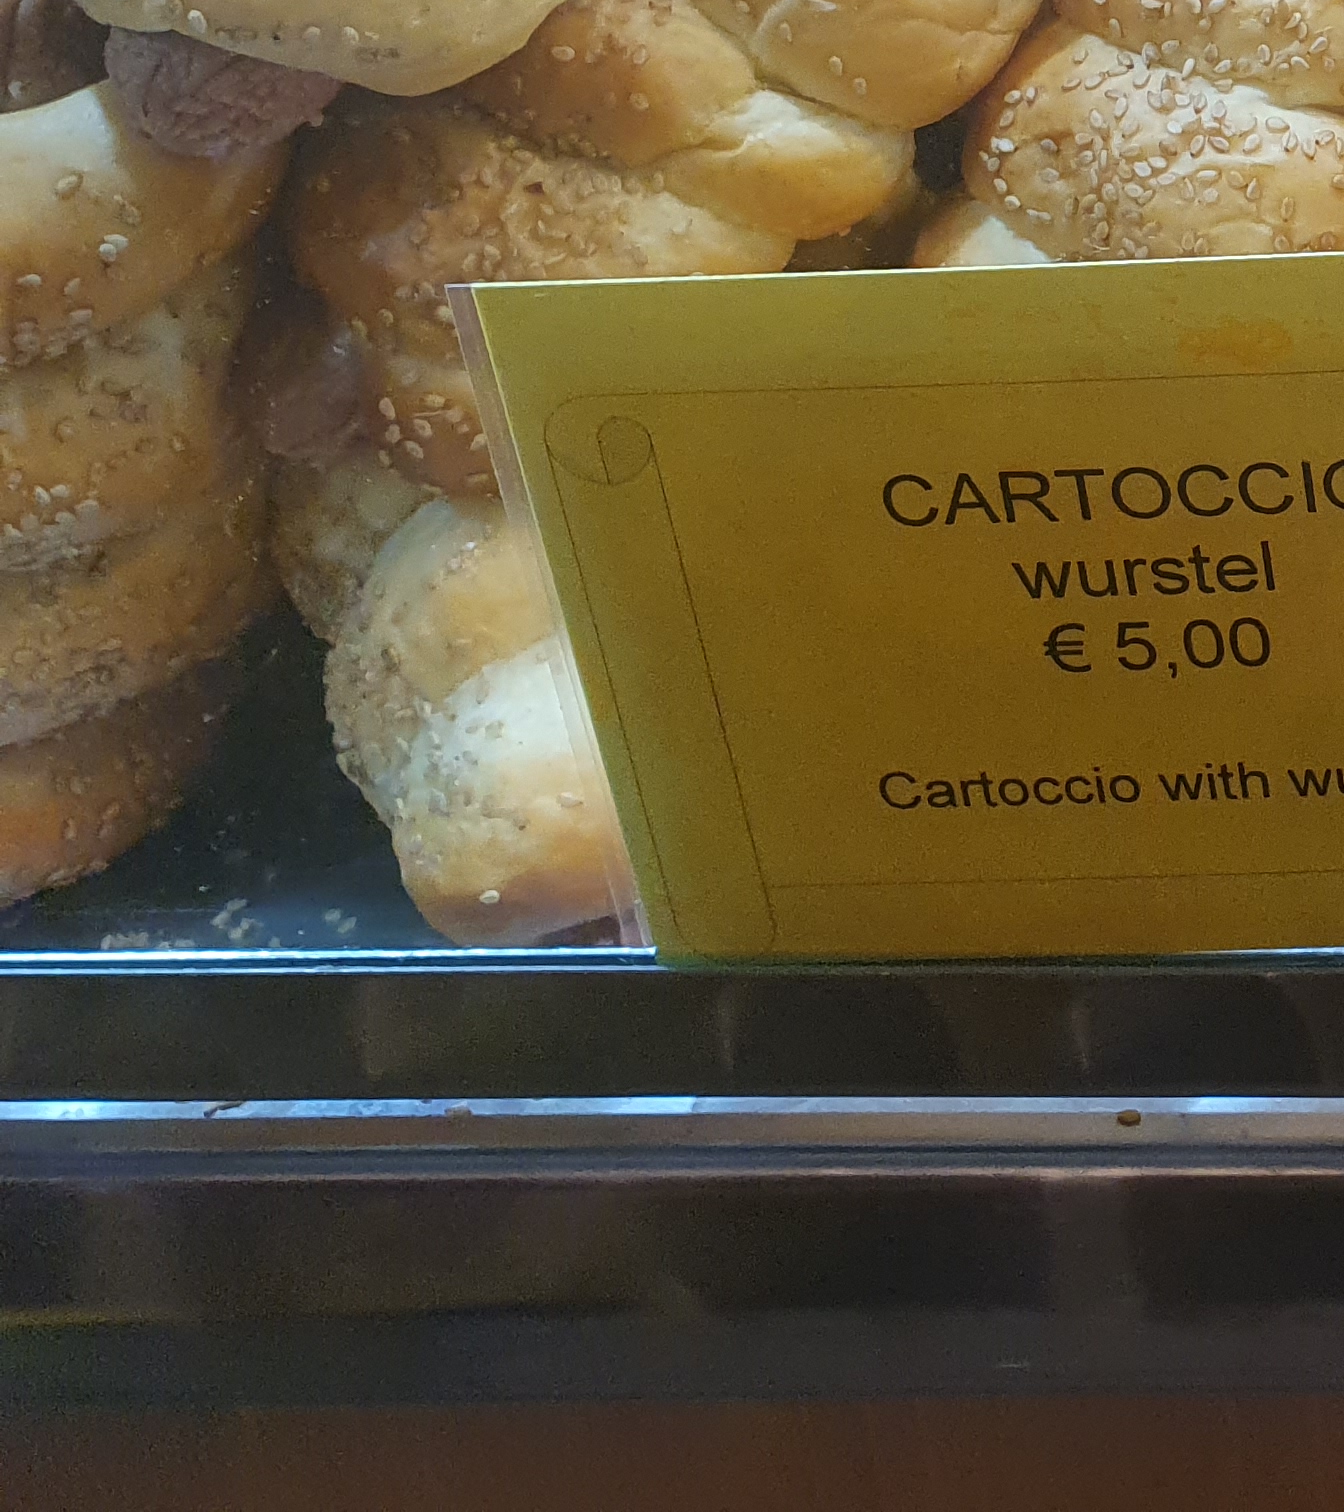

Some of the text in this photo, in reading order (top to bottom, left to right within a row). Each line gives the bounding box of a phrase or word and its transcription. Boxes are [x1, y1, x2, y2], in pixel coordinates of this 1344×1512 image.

[1011, 540, 1276, 599] wurstel
[1042, 616, 1271, 679] € 5,00
[878, 766, 1141, 810] Cartoccio
[1157, 761, 1271, 802] with
